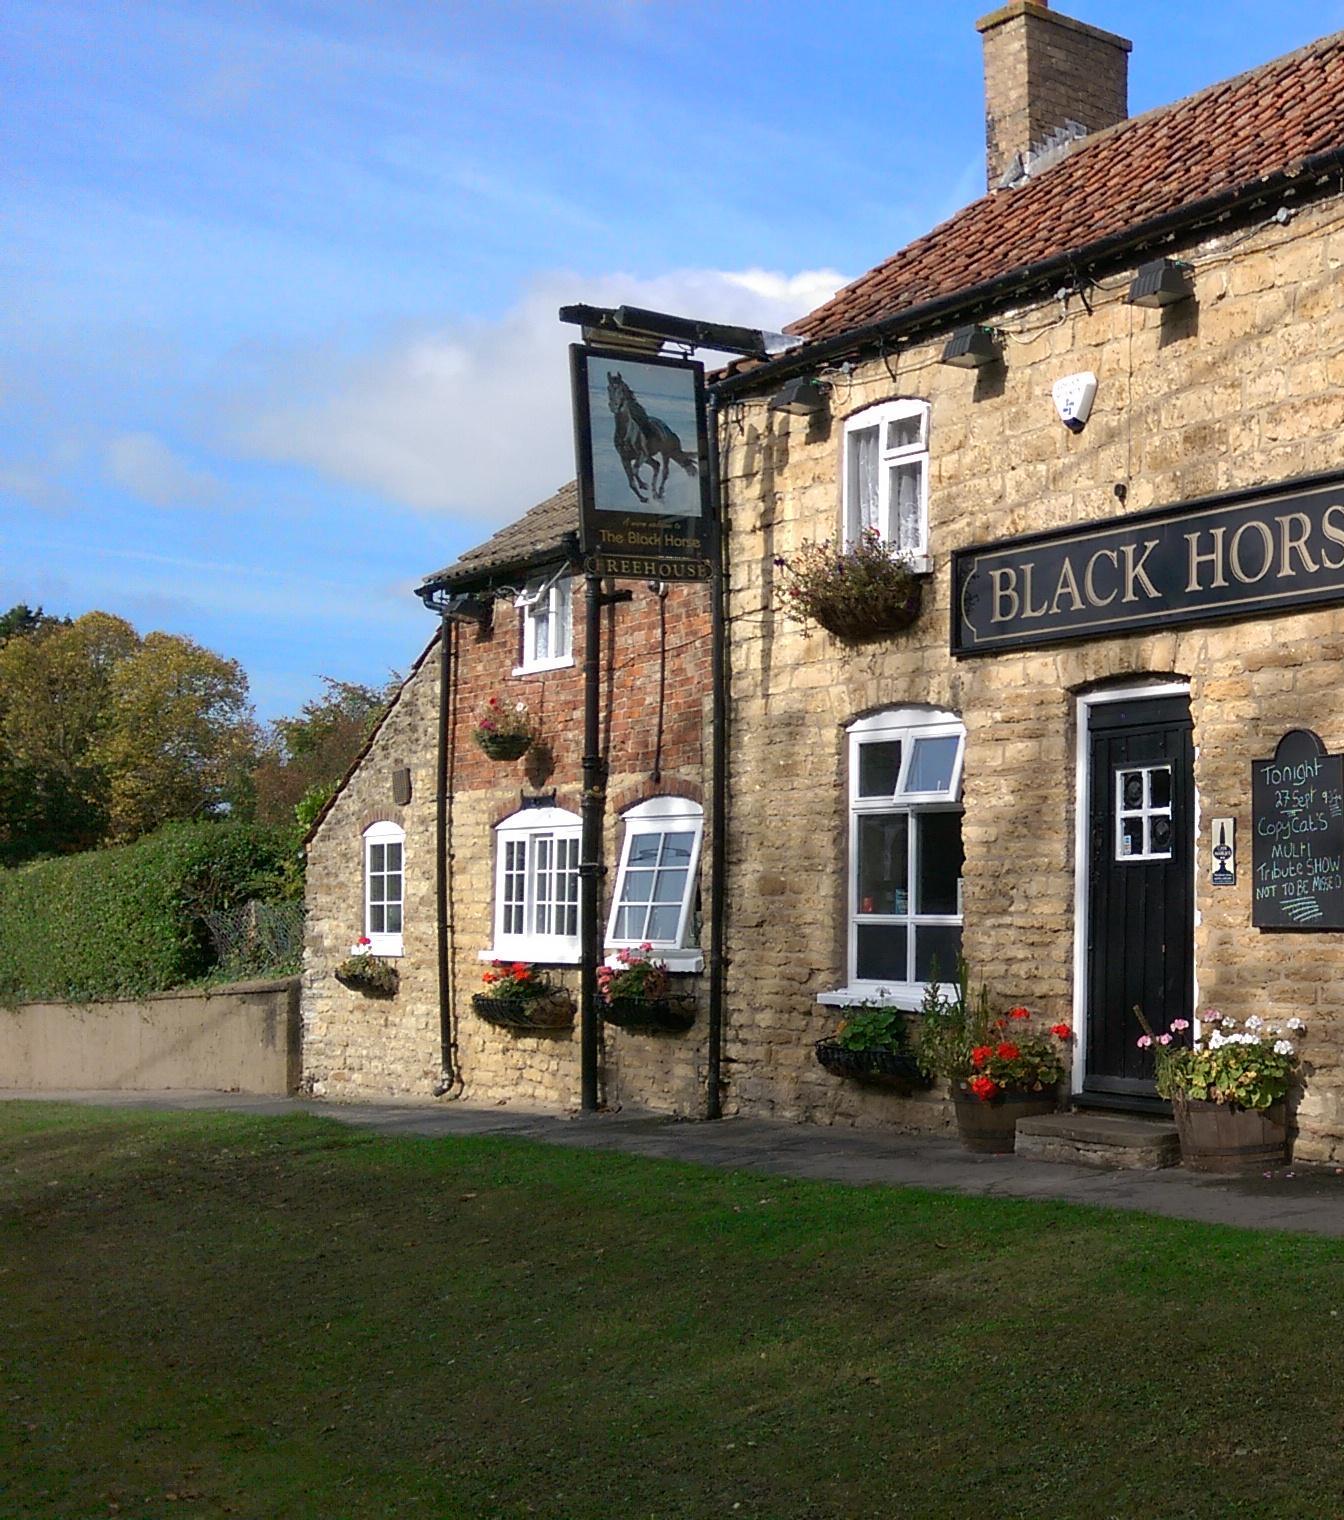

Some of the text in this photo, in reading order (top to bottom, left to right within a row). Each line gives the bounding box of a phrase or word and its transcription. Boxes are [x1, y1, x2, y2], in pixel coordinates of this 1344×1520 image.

[599, 529, 702, 548] The Black Horse
[989, 538, 1162, 624] BLACK
[1260, 757, 1323, 786] Tonight
[1274, 789, 1290, 808] 27
[1292, 785, 1317, 808] Sept
[1256, 856, 1341, 881] Tribute SHOW
[1256, 875, 1342, 900] NOT TO BE MISSED
